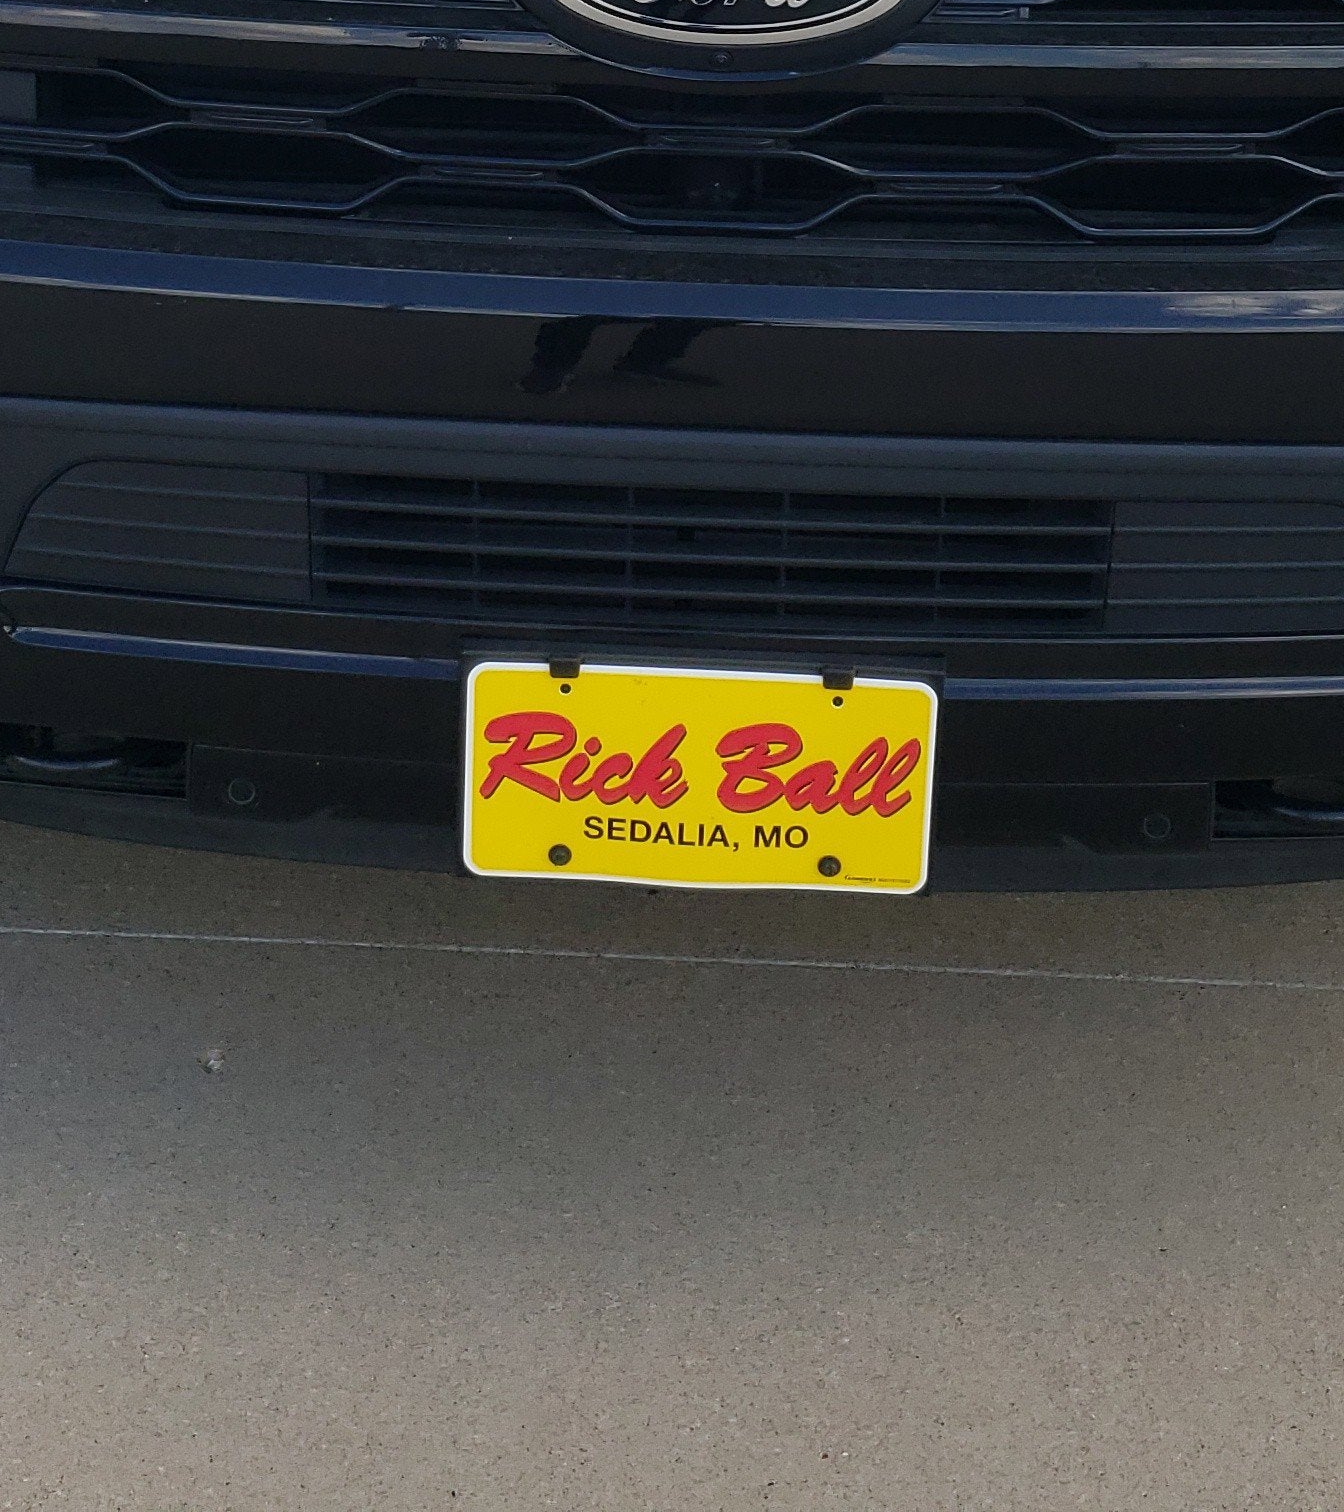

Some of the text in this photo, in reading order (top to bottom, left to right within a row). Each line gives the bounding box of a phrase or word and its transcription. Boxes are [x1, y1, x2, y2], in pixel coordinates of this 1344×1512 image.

[479, 711, 922, 818] Rick Ball
[582, 815, 810, 852] SEDALIA, MO
